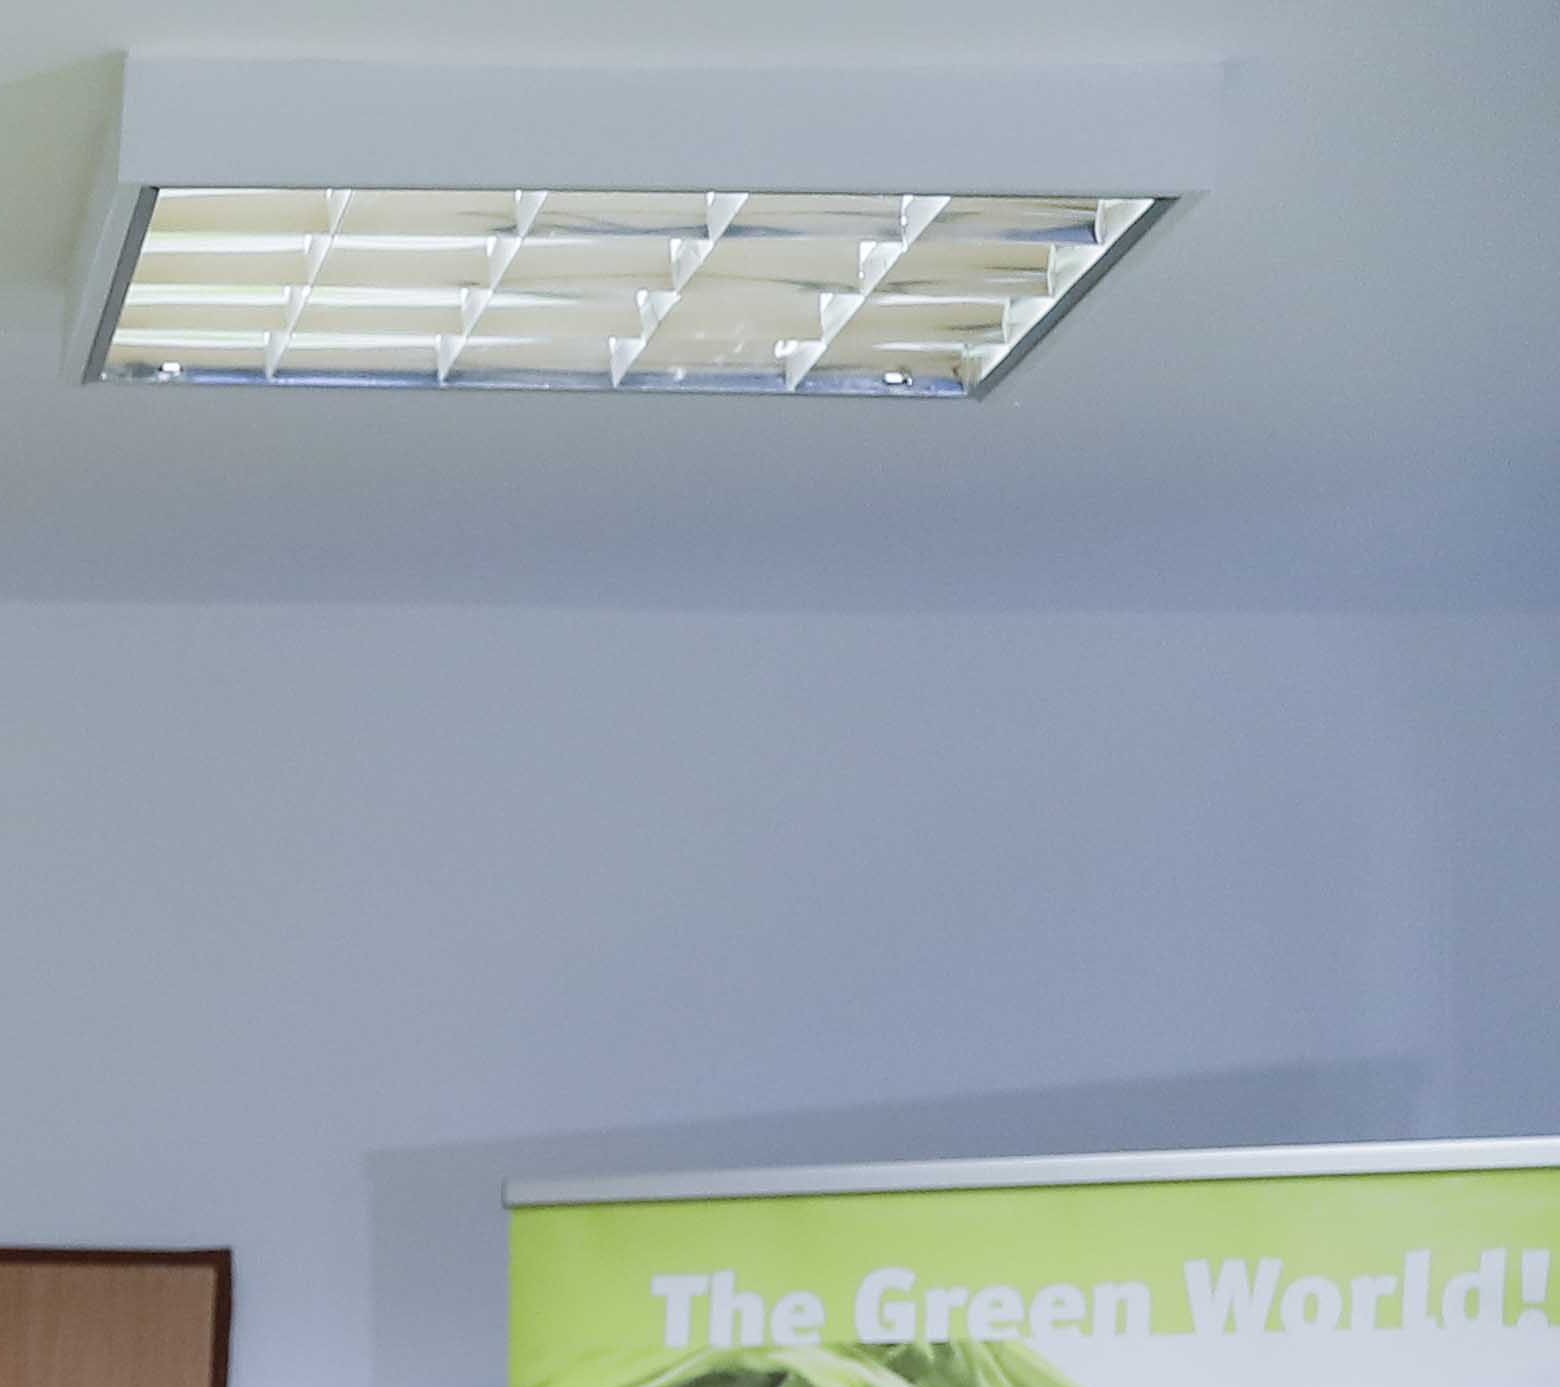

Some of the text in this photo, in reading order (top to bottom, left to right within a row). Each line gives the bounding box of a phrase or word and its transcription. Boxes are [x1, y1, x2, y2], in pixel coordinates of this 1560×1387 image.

[651, 1247, 1552, 1349] The Green World!
